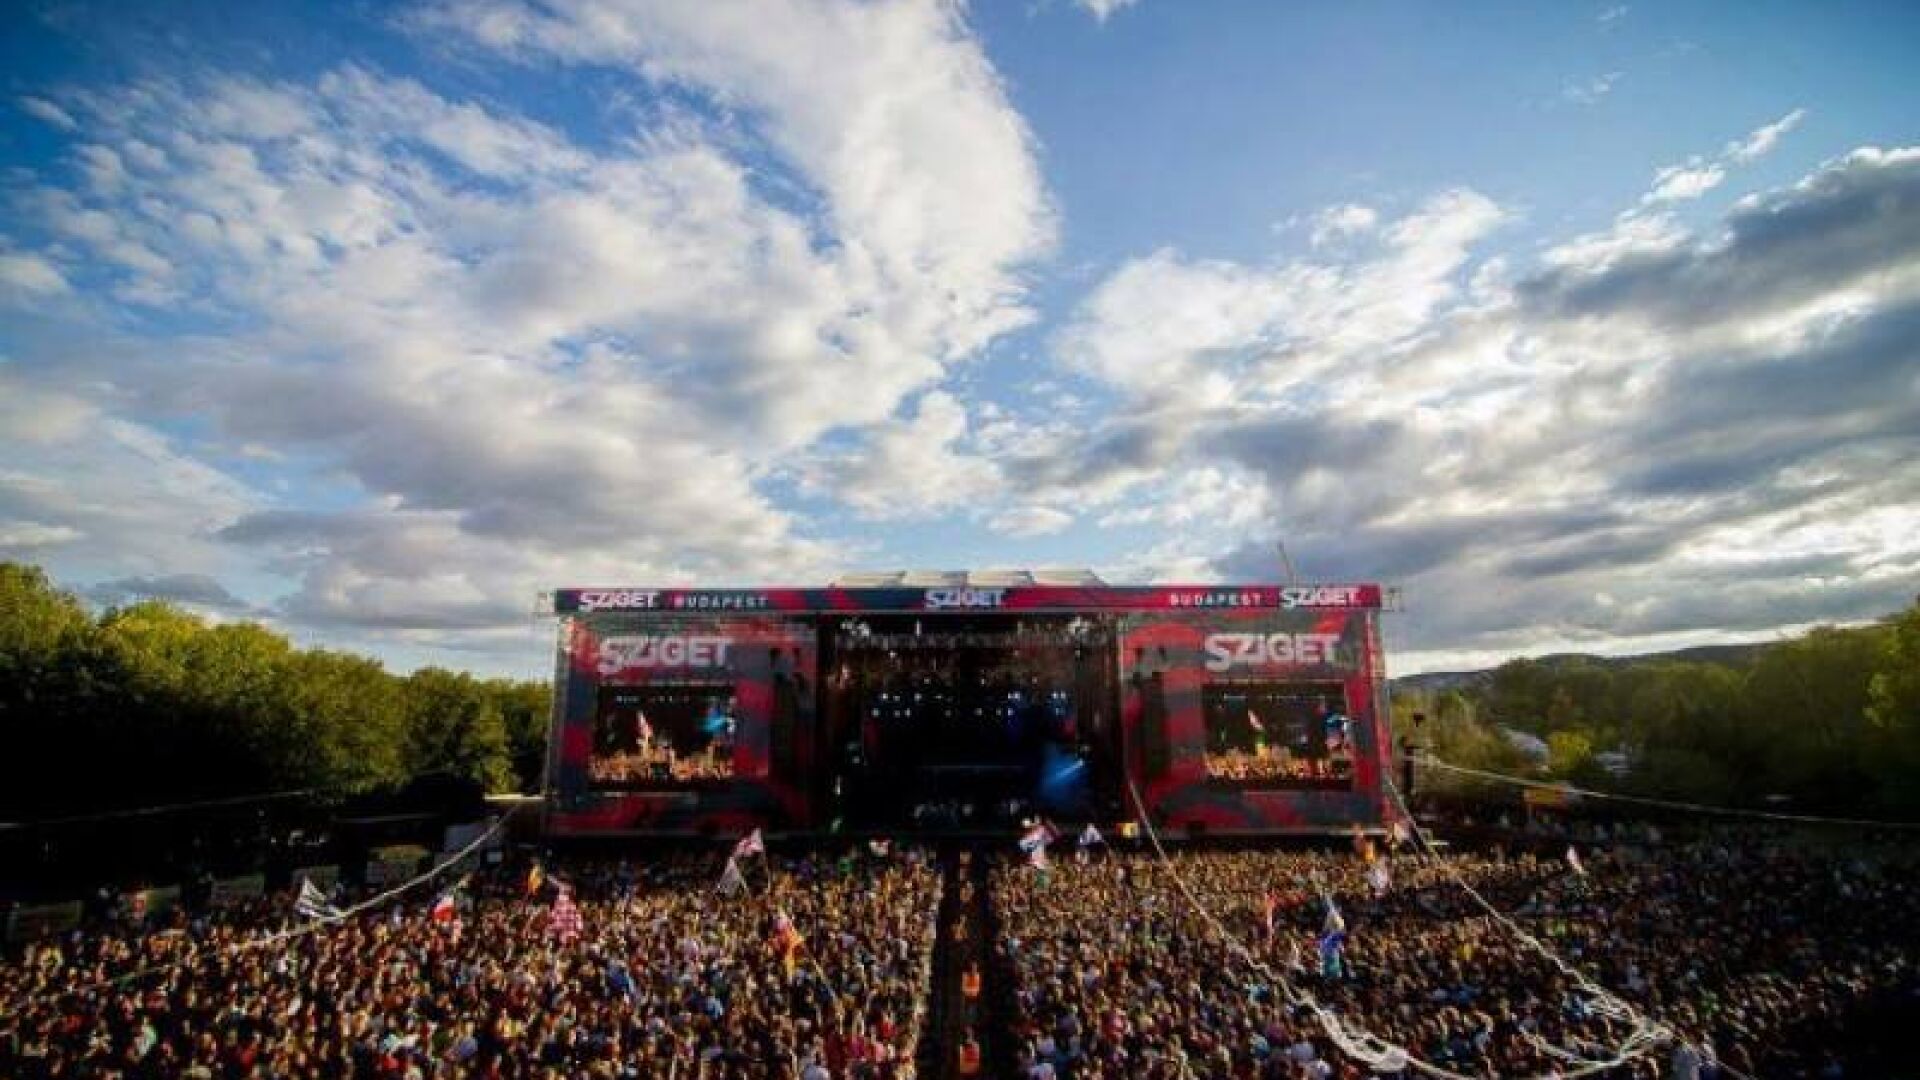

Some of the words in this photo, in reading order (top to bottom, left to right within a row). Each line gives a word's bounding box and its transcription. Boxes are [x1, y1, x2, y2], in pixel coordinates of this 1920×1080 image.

[578, 591, 659, 611] SZIGET
[674, 593, 769, 607] BUDAPEST
[925, 588, 1003, 608] SZIGET
[1169, 593, 1262, 606] BUDAPEST
[1280, 587, 1361, 608] SZIGET
[598, 636, 733, 674] SZIGET
[1204, 633, 1341, 670] SZIGET
